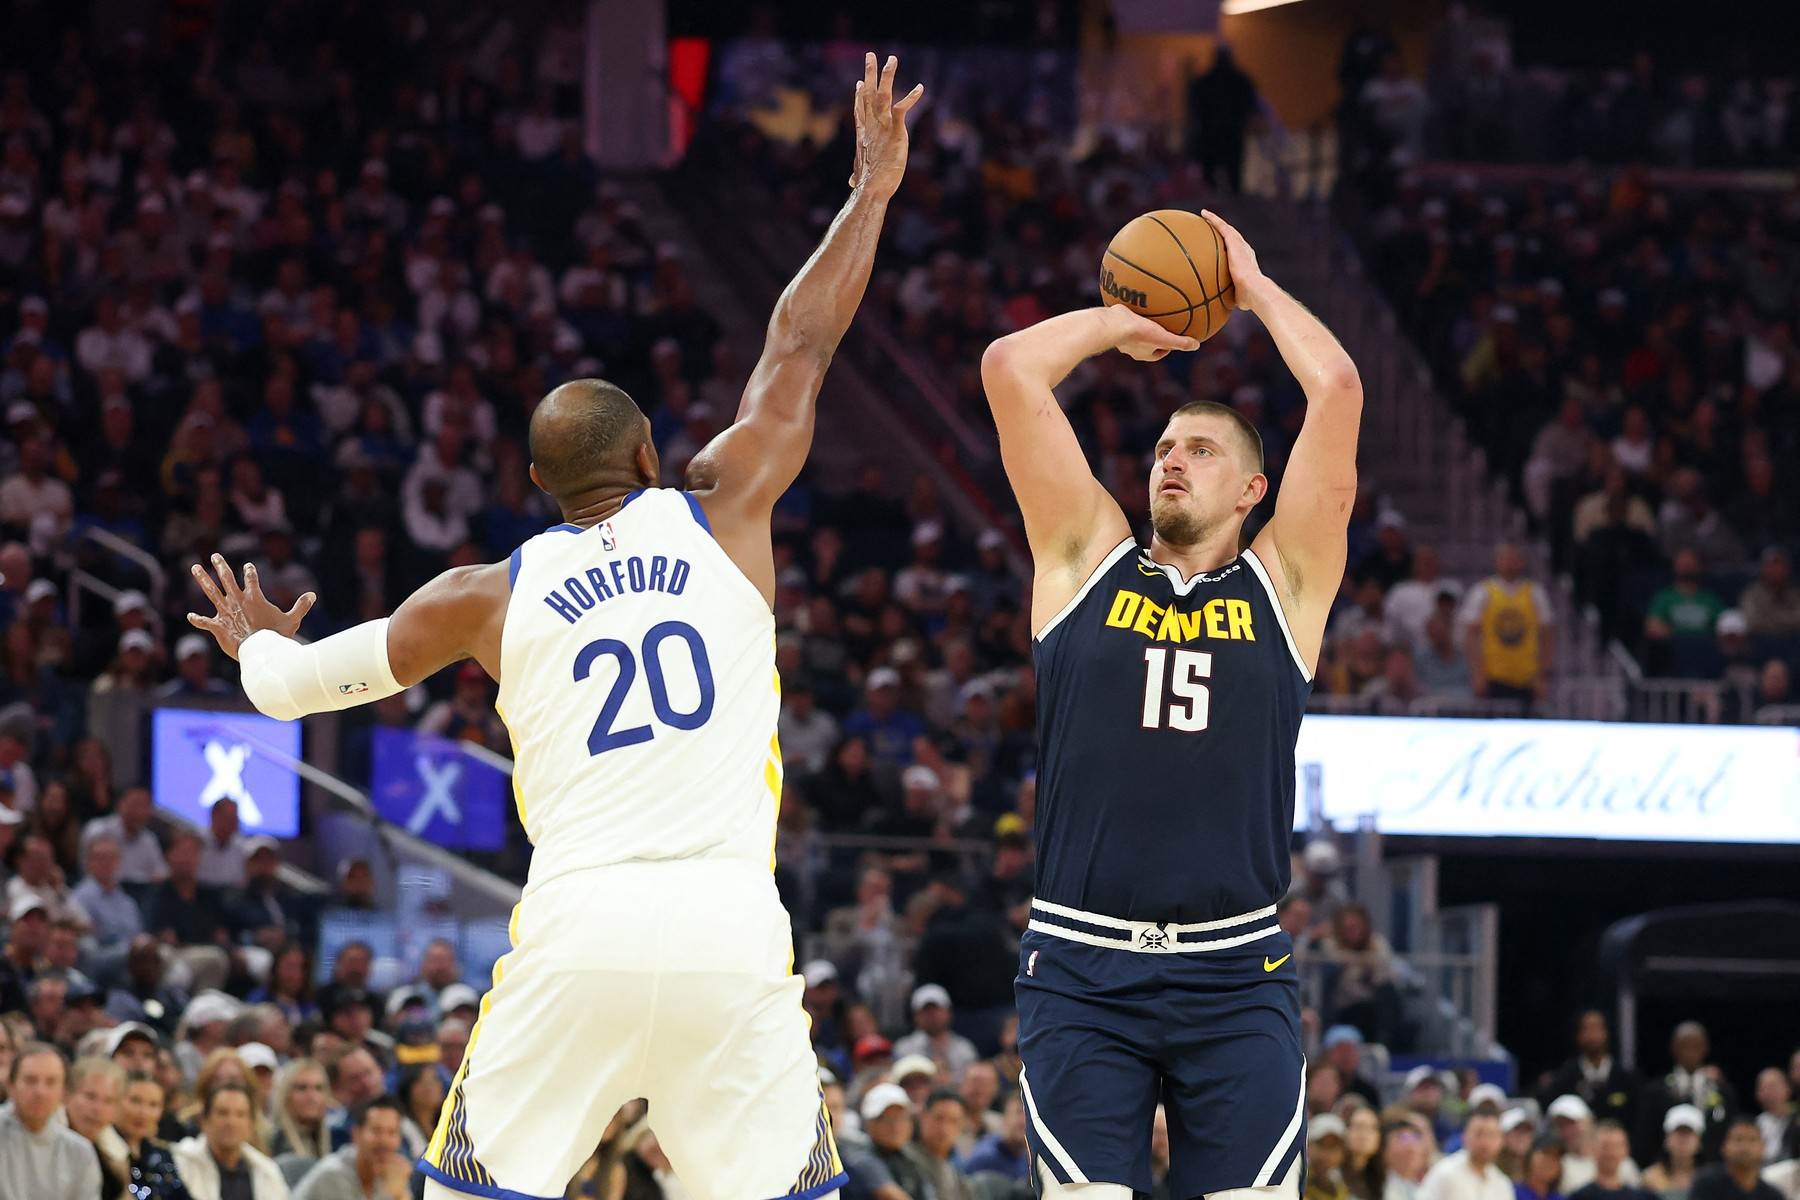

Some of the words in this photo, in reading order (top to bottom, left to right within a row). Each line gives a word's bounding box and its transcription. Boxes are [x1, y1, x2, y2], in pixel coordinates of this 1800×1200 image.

[1101, 264, 1148, 309] ilson
[543, 555, 691, 625] HORFORD
[1105, 589, 1256, 643] DENVER
[572, 620, 716, 757] 20
[1141, 646, 1213, 732] 15
